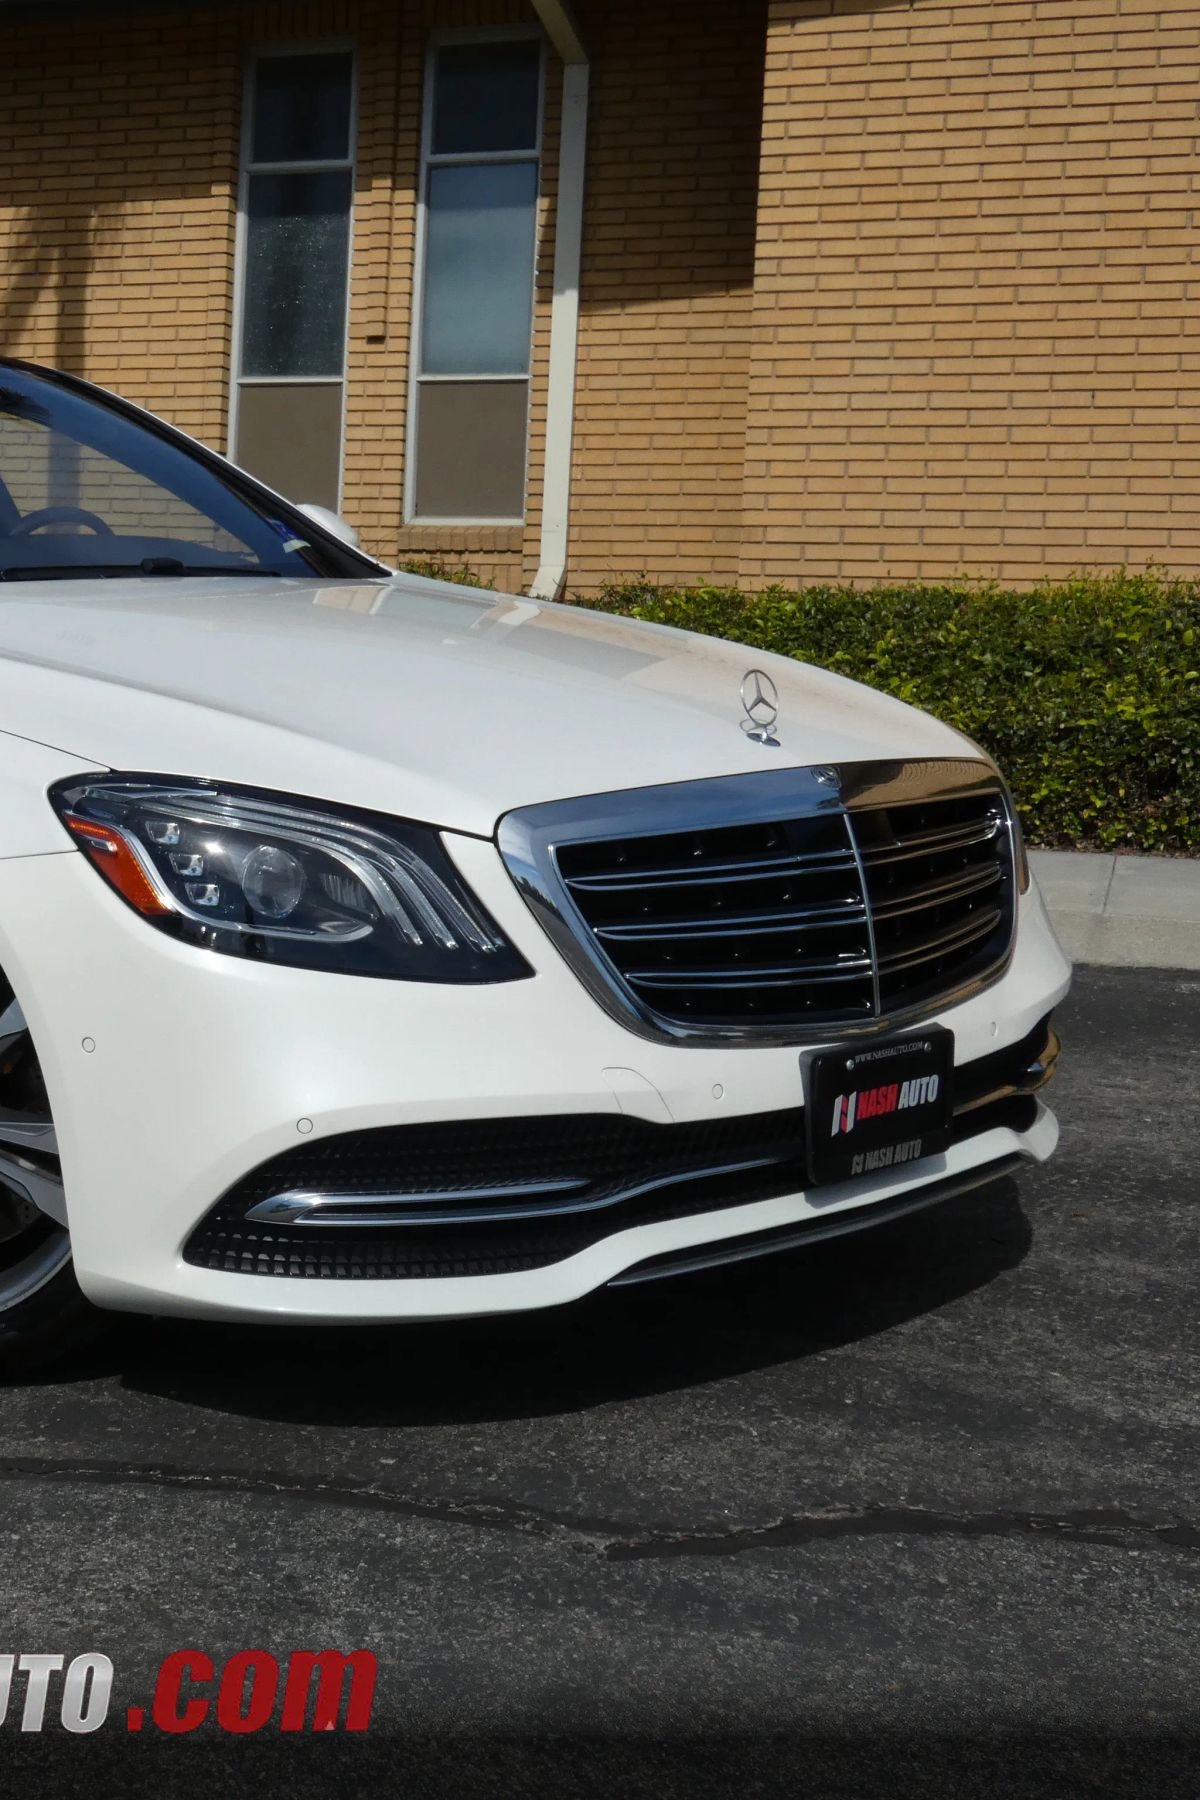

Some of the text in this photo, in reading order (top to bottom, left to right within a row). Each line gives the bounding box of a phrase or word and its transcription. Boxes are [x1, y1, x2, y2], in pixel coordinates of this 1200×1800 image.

[857, 1083, 898, 1120] NASH
[898, 1074, 939, 1109] AUTO
[865, 1146, 893, 1171] NASH
[894, 1139, 922, 1164] AUTO
